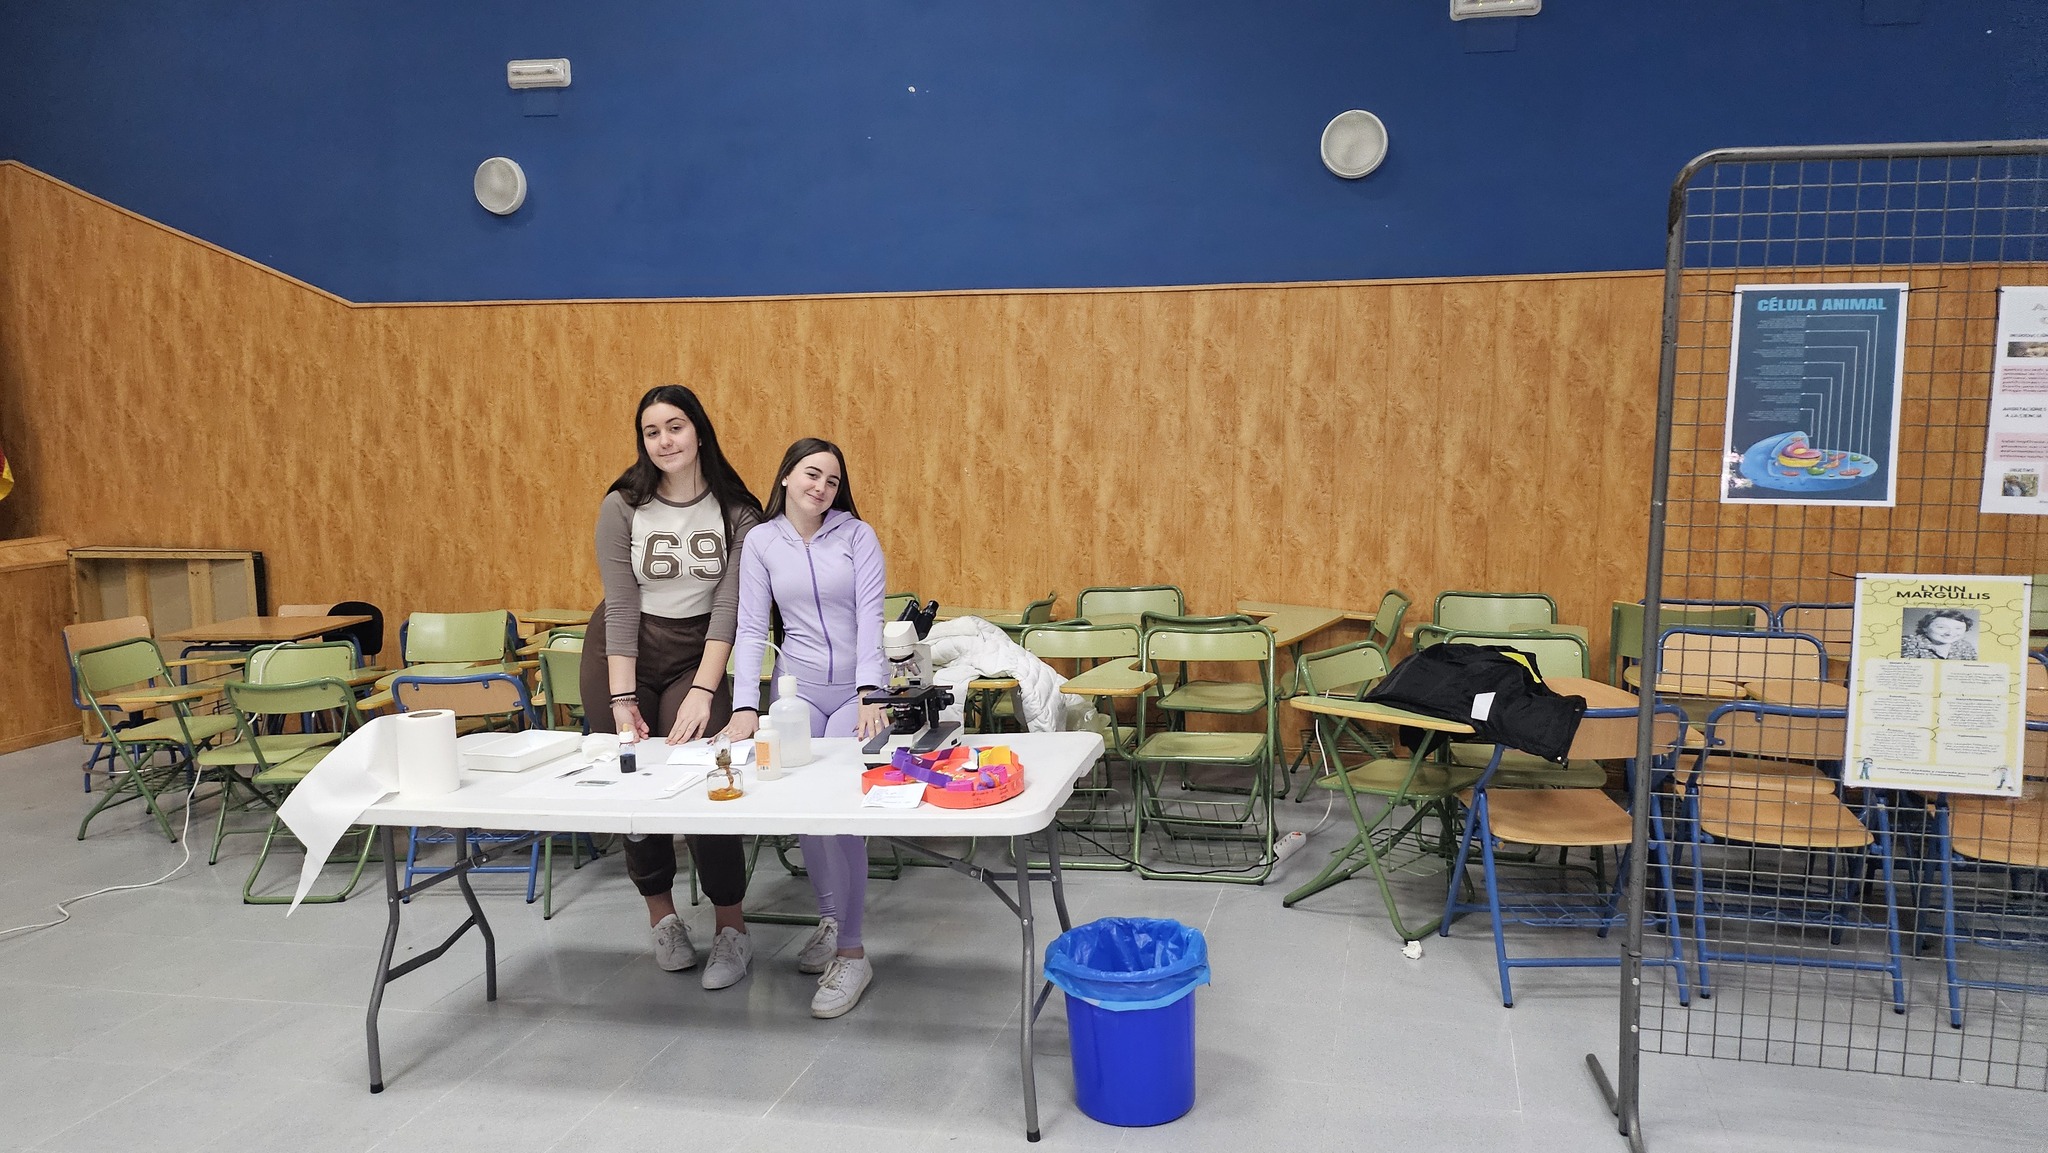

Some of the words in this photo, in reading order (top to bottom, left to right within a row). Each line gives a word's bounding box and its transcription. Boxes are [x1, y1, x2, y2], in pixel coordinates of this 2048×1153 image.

[1757, 296, 1817, 312] CÉLULA
[1822, 298, 1887, 311] ANIMAL
[639, 529, 728, 581] 69
[1921, 584, 1966, 592] LYNN
[1896, 591, 1991, 600] MARGULLIS
